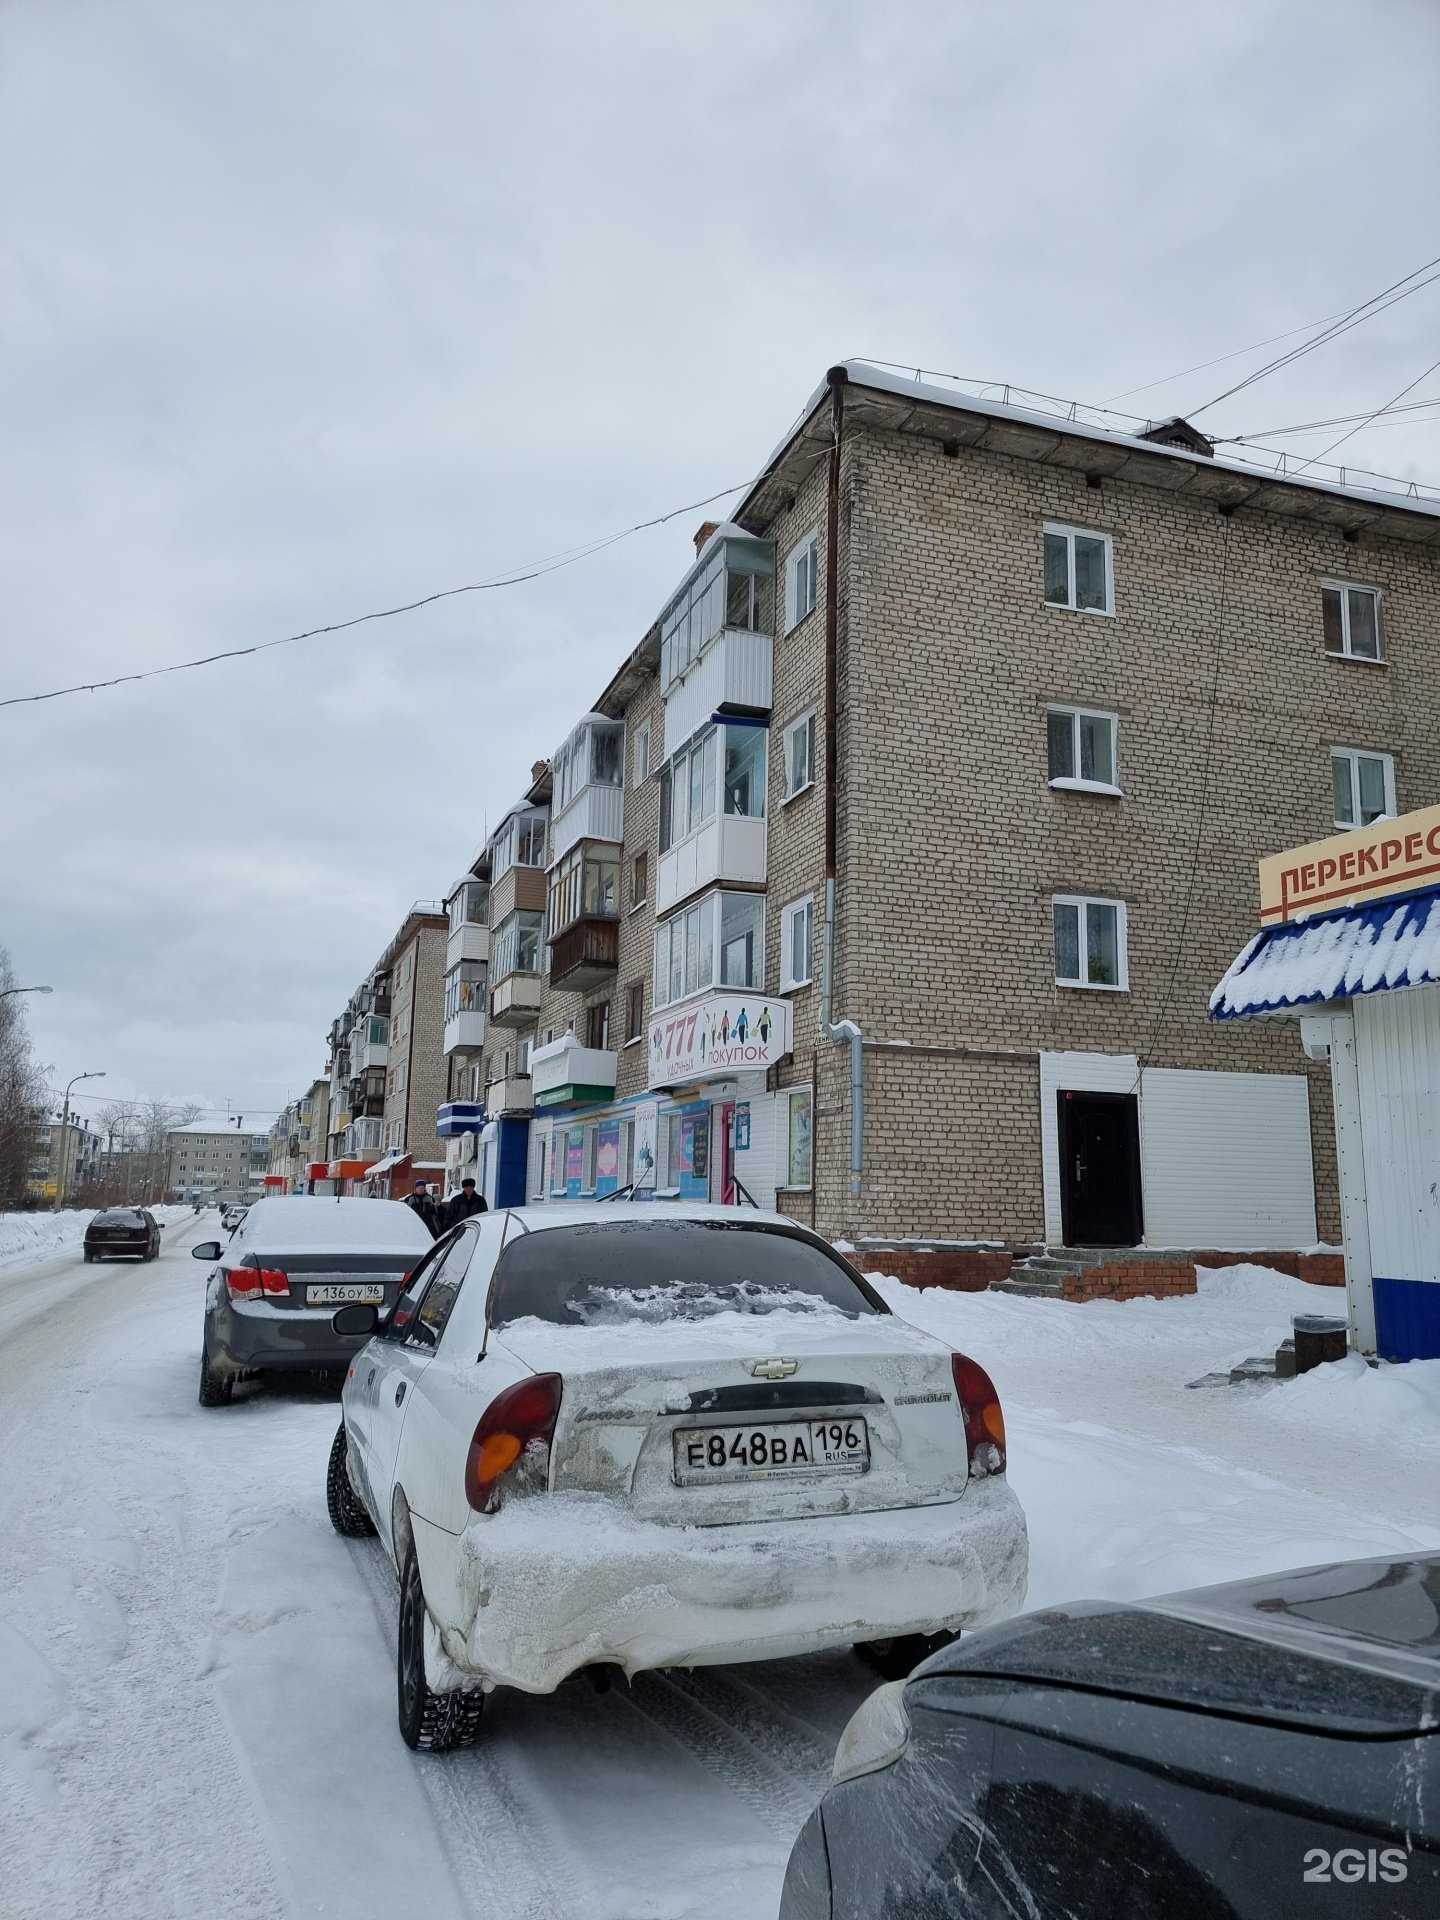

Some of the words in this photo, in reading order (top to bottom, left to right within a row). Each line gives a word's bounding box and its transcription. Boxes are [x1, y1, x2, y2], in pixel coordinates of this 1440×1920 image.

[665, 1010, 699, 1060] 777
[367, 1285, 380, 1295] 96
[815, 1424, 858, 1450] 196
[825, 1451, 847, 1462] RUS
